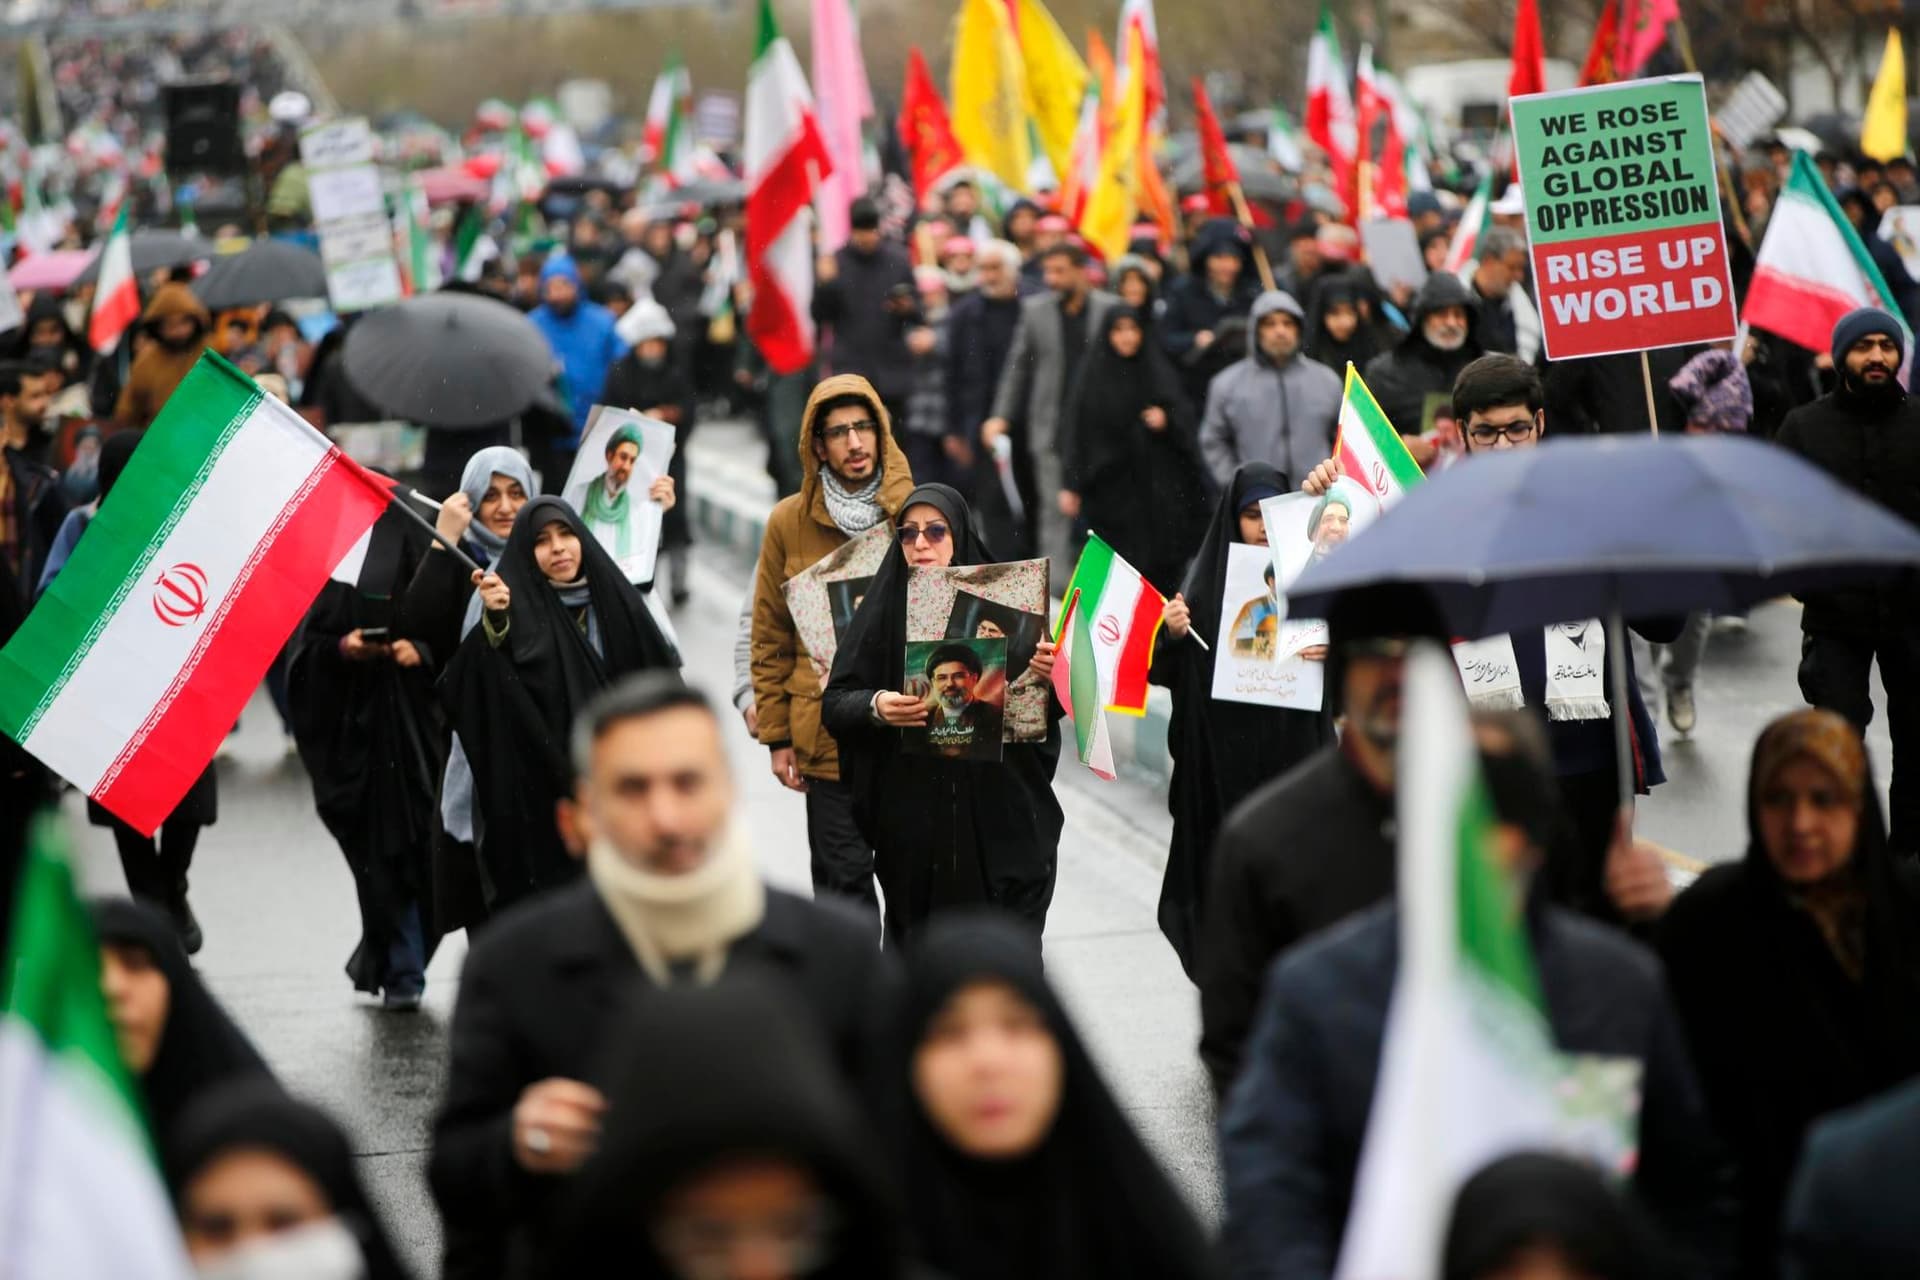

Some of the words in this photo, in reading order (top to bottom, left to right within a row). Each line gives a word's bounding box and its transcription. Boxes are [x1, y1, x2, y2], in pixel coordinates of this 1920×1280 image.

[1540, 113, 1587, 137] WE
[1597, 101, 1679, 130] ROSE
[1541, 129, 1687, 168] AGAINST
[1543, 158, 1694, 197] GLOBAL
[1537, 185, 1709, 232] OPPRESSION
[1546, 245, 1645, 284] RISE
[1658, 236, 1716, 270] UP
[1550, 276, 1723, 325] WORLD
